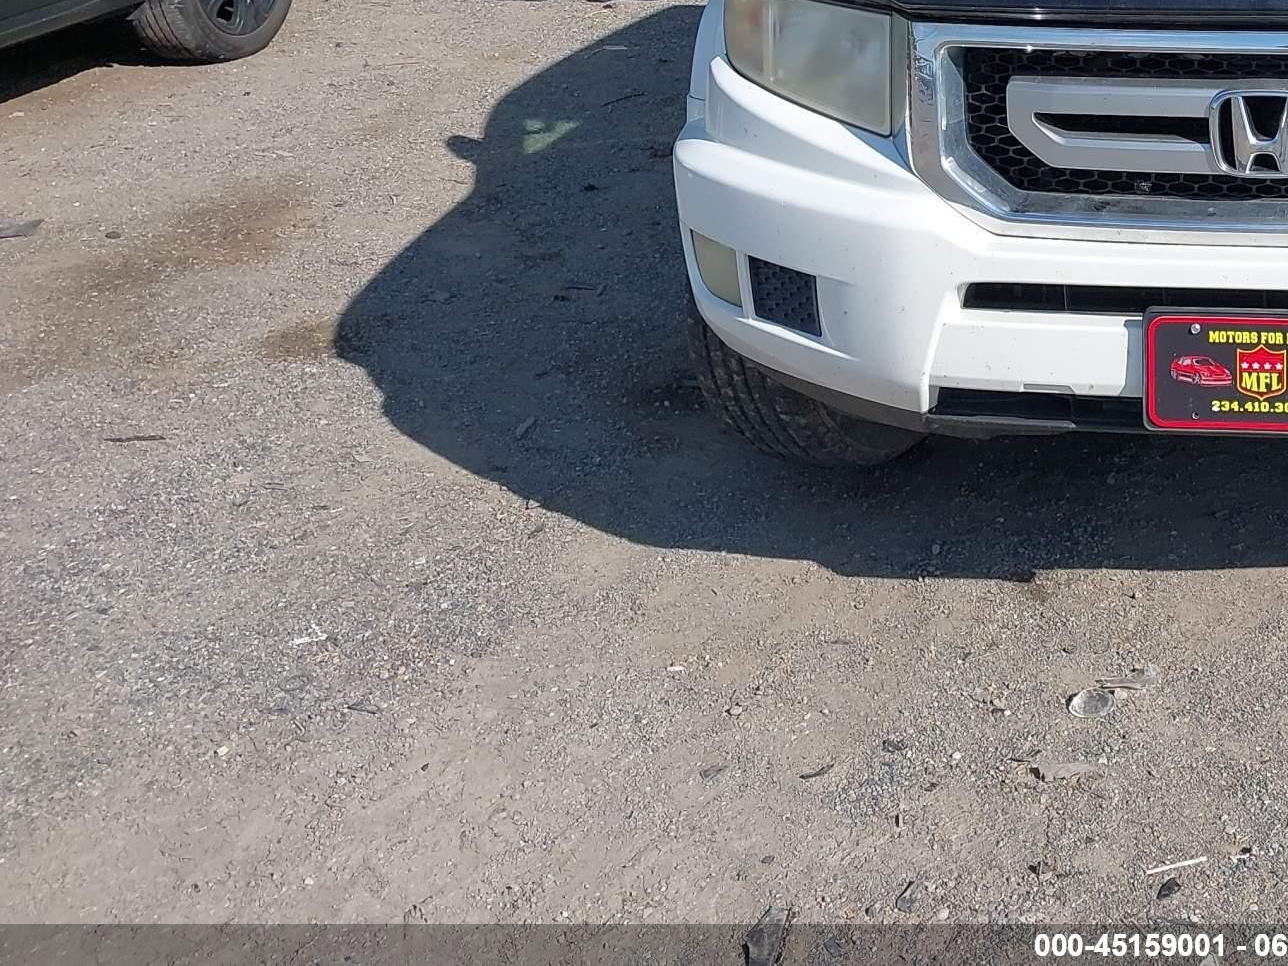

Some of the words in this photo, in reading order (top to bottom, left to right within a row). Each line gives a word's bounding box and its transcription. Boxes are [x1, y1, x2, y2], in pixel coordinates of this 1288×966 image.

[1208, 330, 1258, 345] MOTORS
[1261, 332, 1282, 345] FOR
[1241, 371, 1283, 393] MFL
